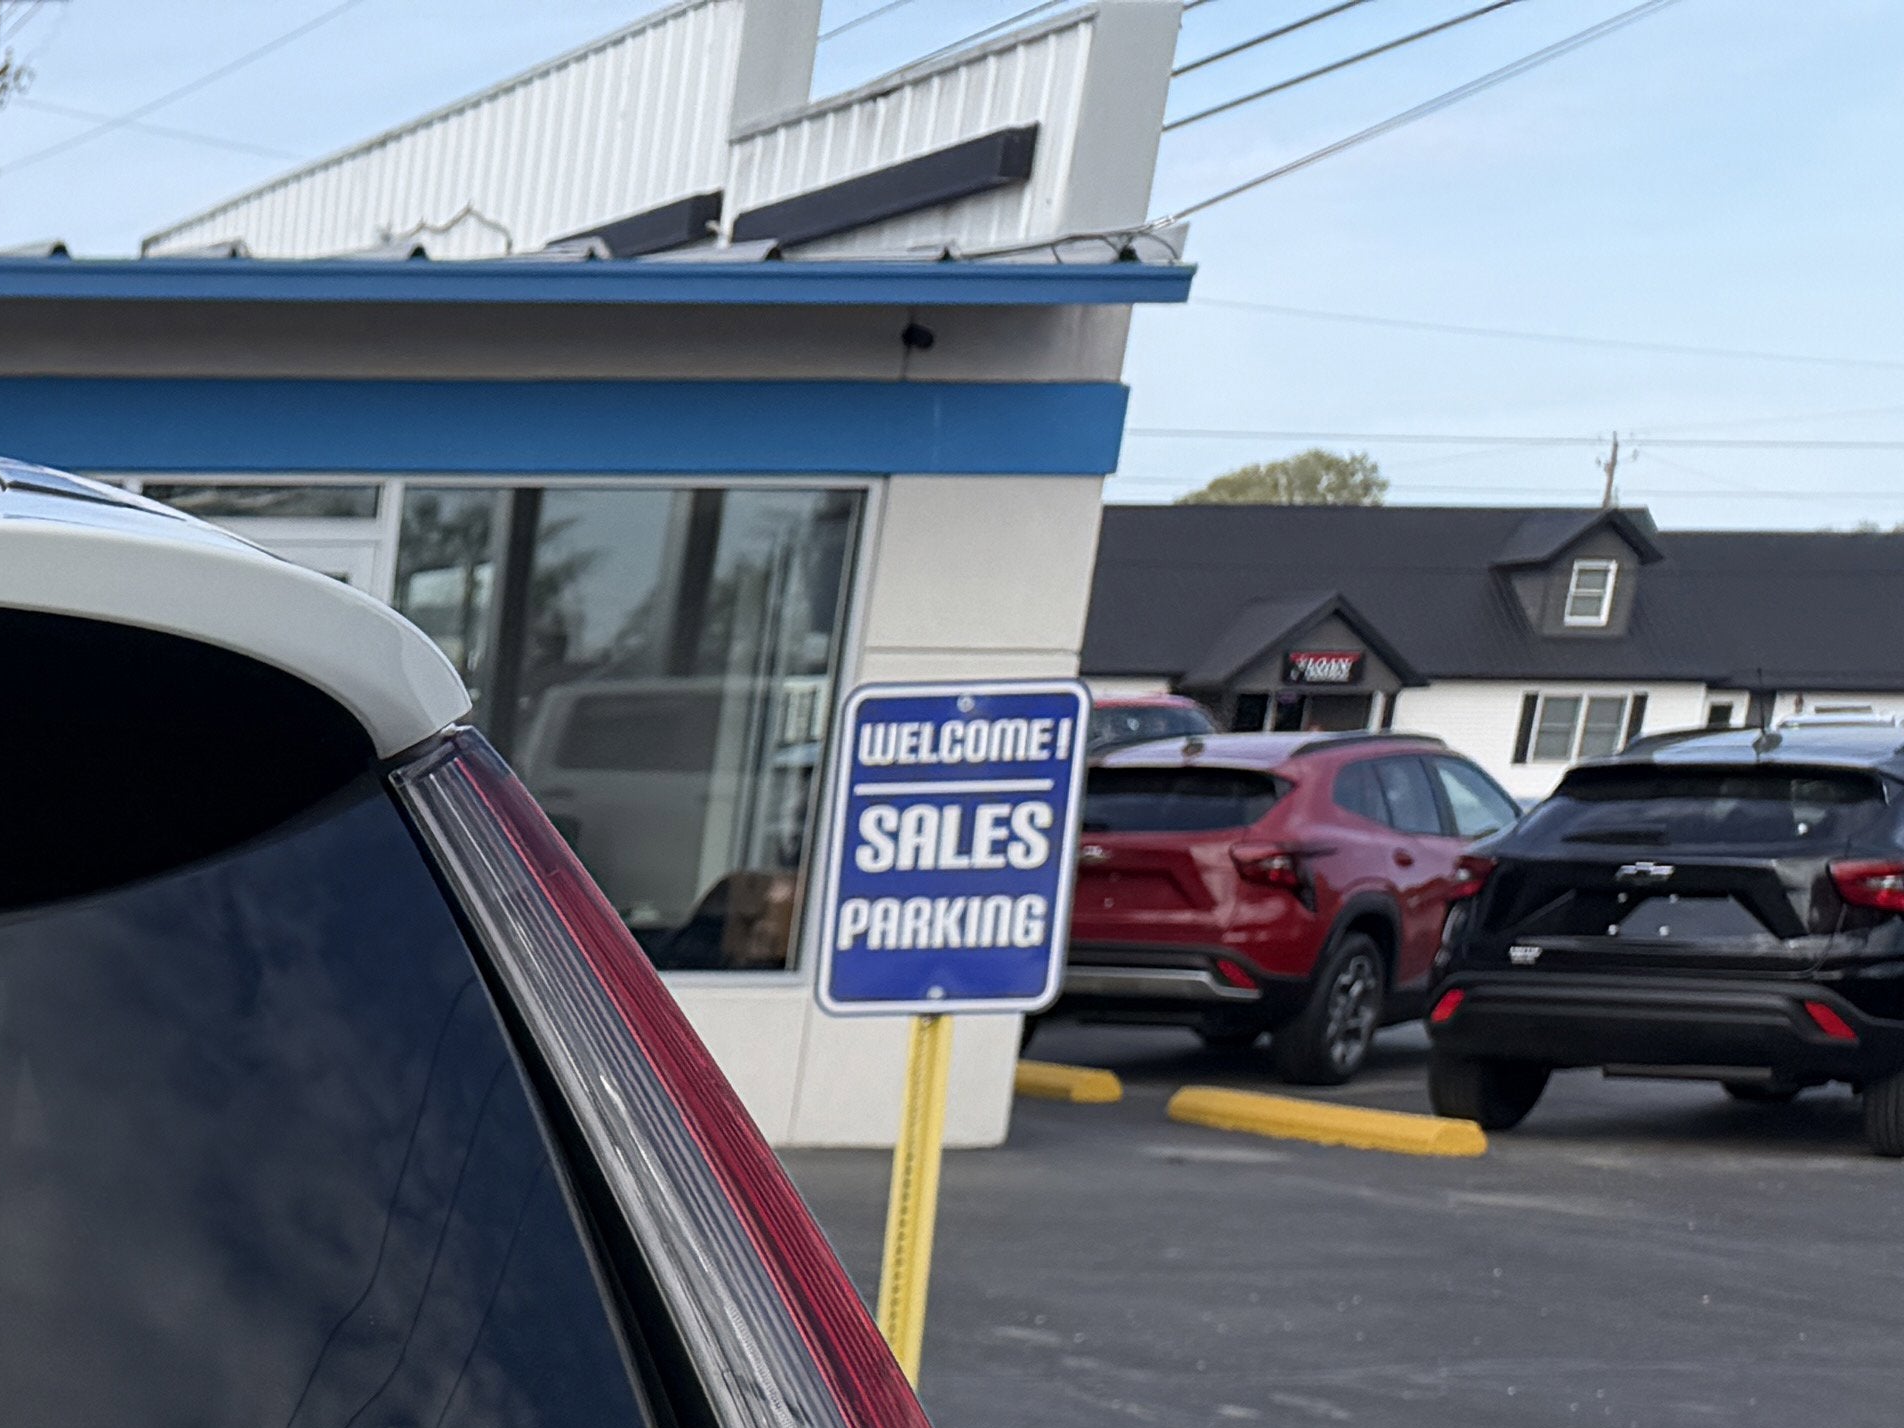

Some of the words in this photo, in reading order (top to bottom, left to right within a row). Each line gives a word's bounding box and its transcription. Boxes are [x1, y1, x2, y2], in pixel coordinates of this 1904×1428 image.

[858, 717, 1073, 766] WELCOME!
[855, 801, 1053, 873] SALES
[837, 894, 1047, 951] PARKING
